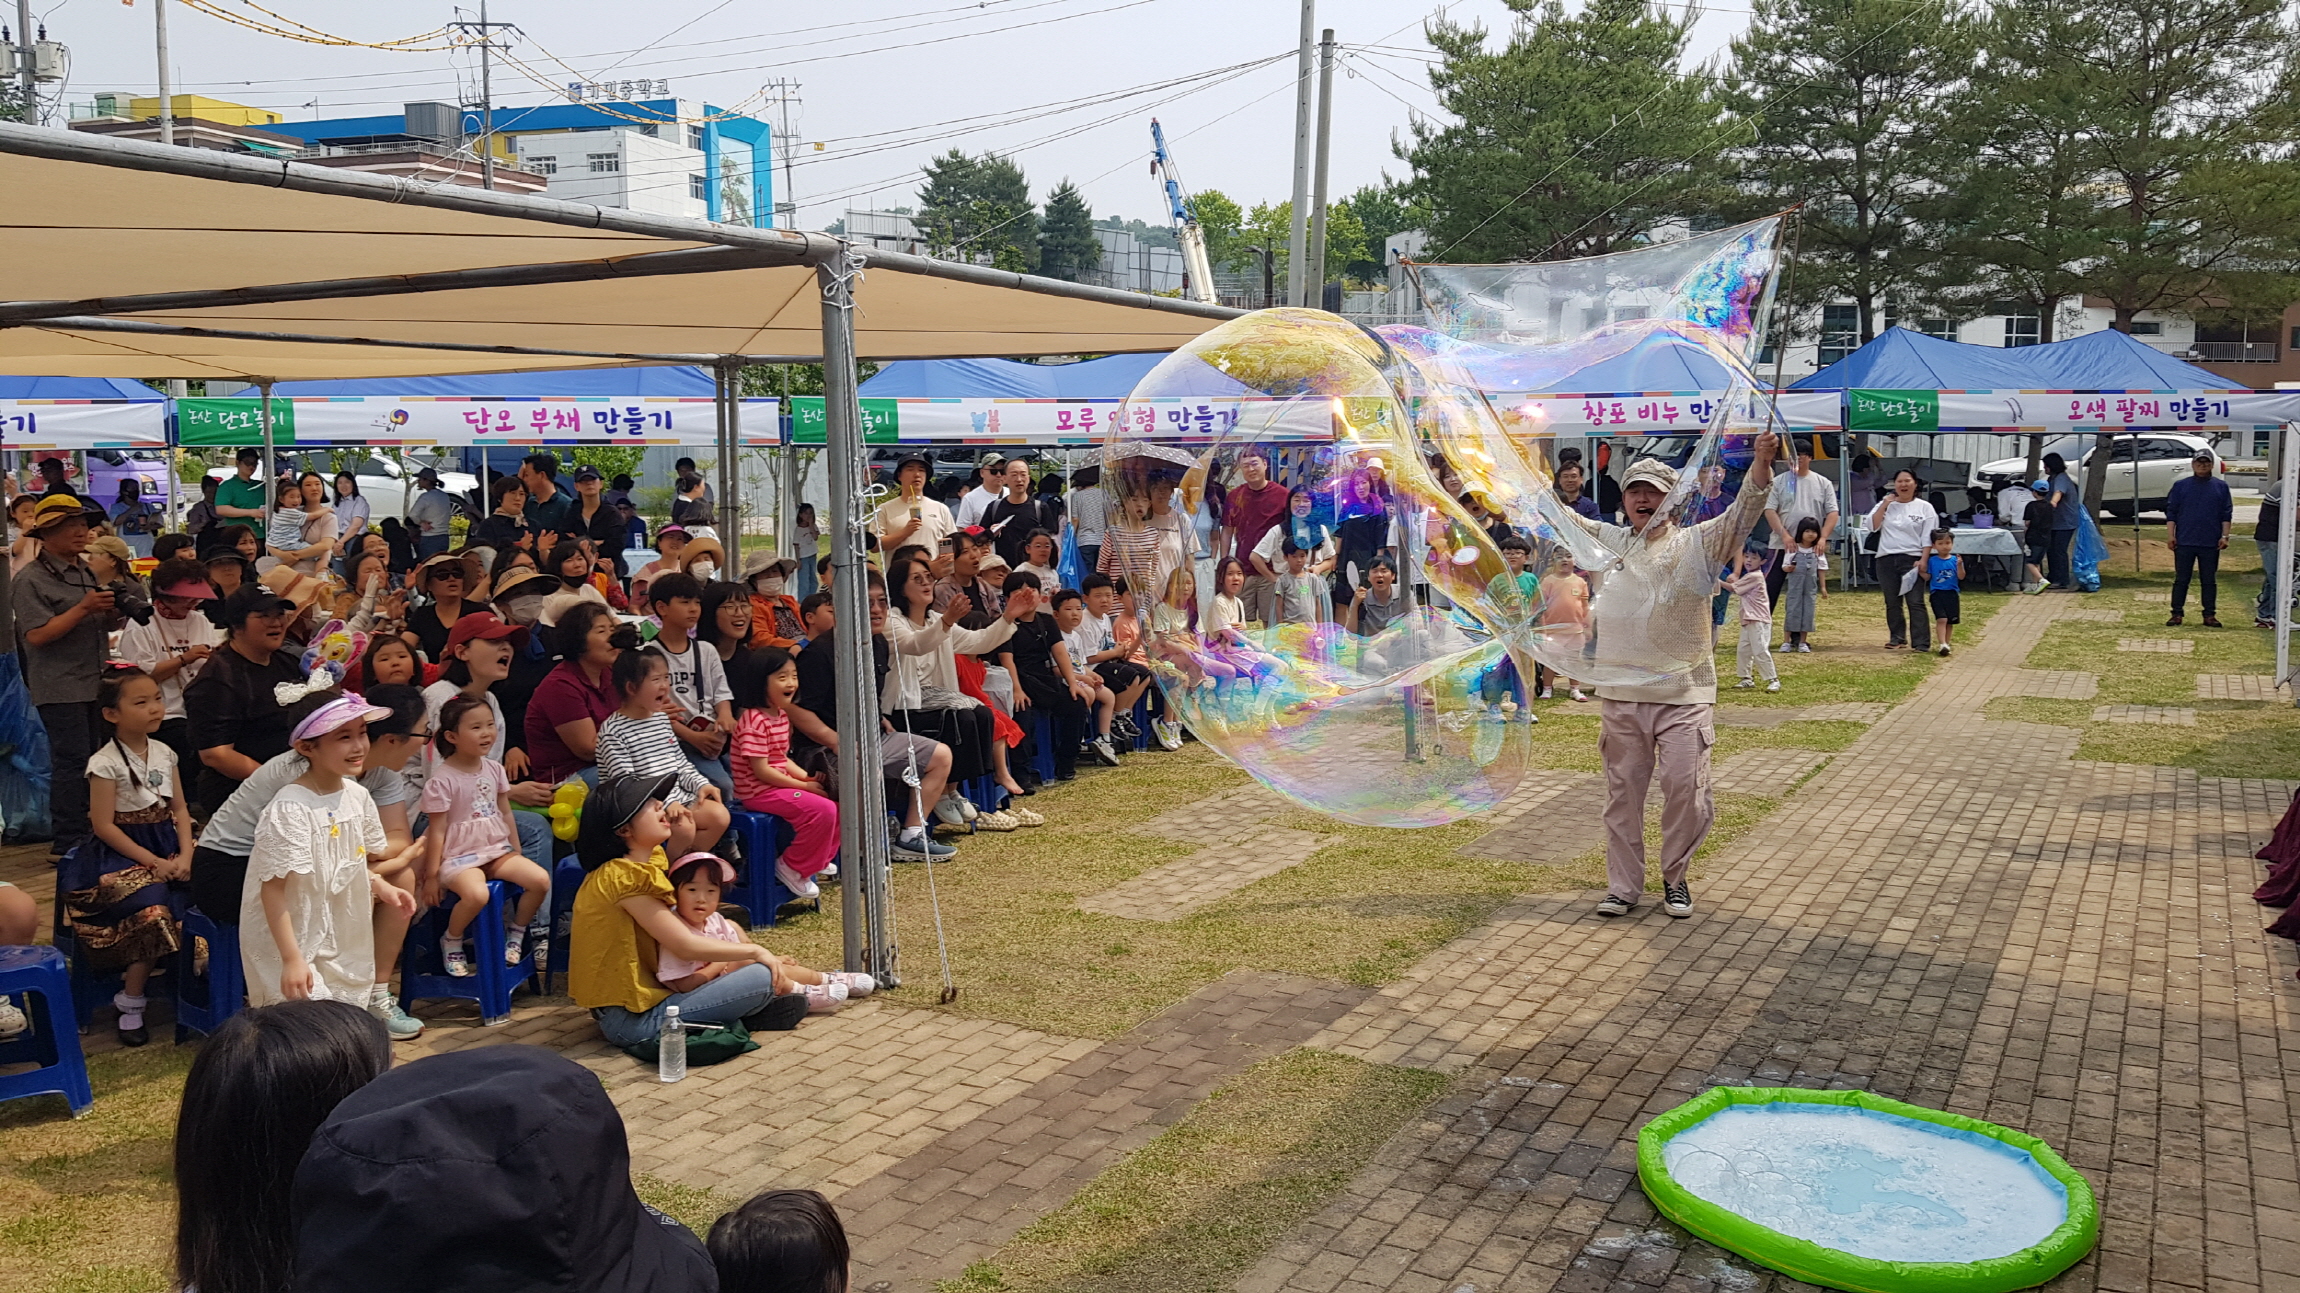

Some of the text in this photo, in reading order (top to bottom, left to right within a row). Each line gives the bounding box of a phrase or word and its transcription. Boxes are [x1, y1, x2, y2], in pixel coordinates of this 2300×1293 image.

[188, 408, 212, 424] 논산
[462, 406, 673, 436] 단오 부채 만들기
[801, 407, 825, 424] 논산
[1056, 407, 1097, 433] 모루
[1167, 405, 1239, 433] 만들기
[1582, 399, 1756, 426] 창포 비누 만기
[1857, 397, 1931, 424] 논산 단오놀이
[2068, 397, 2230, 423] 오색 팔찌 만들기
